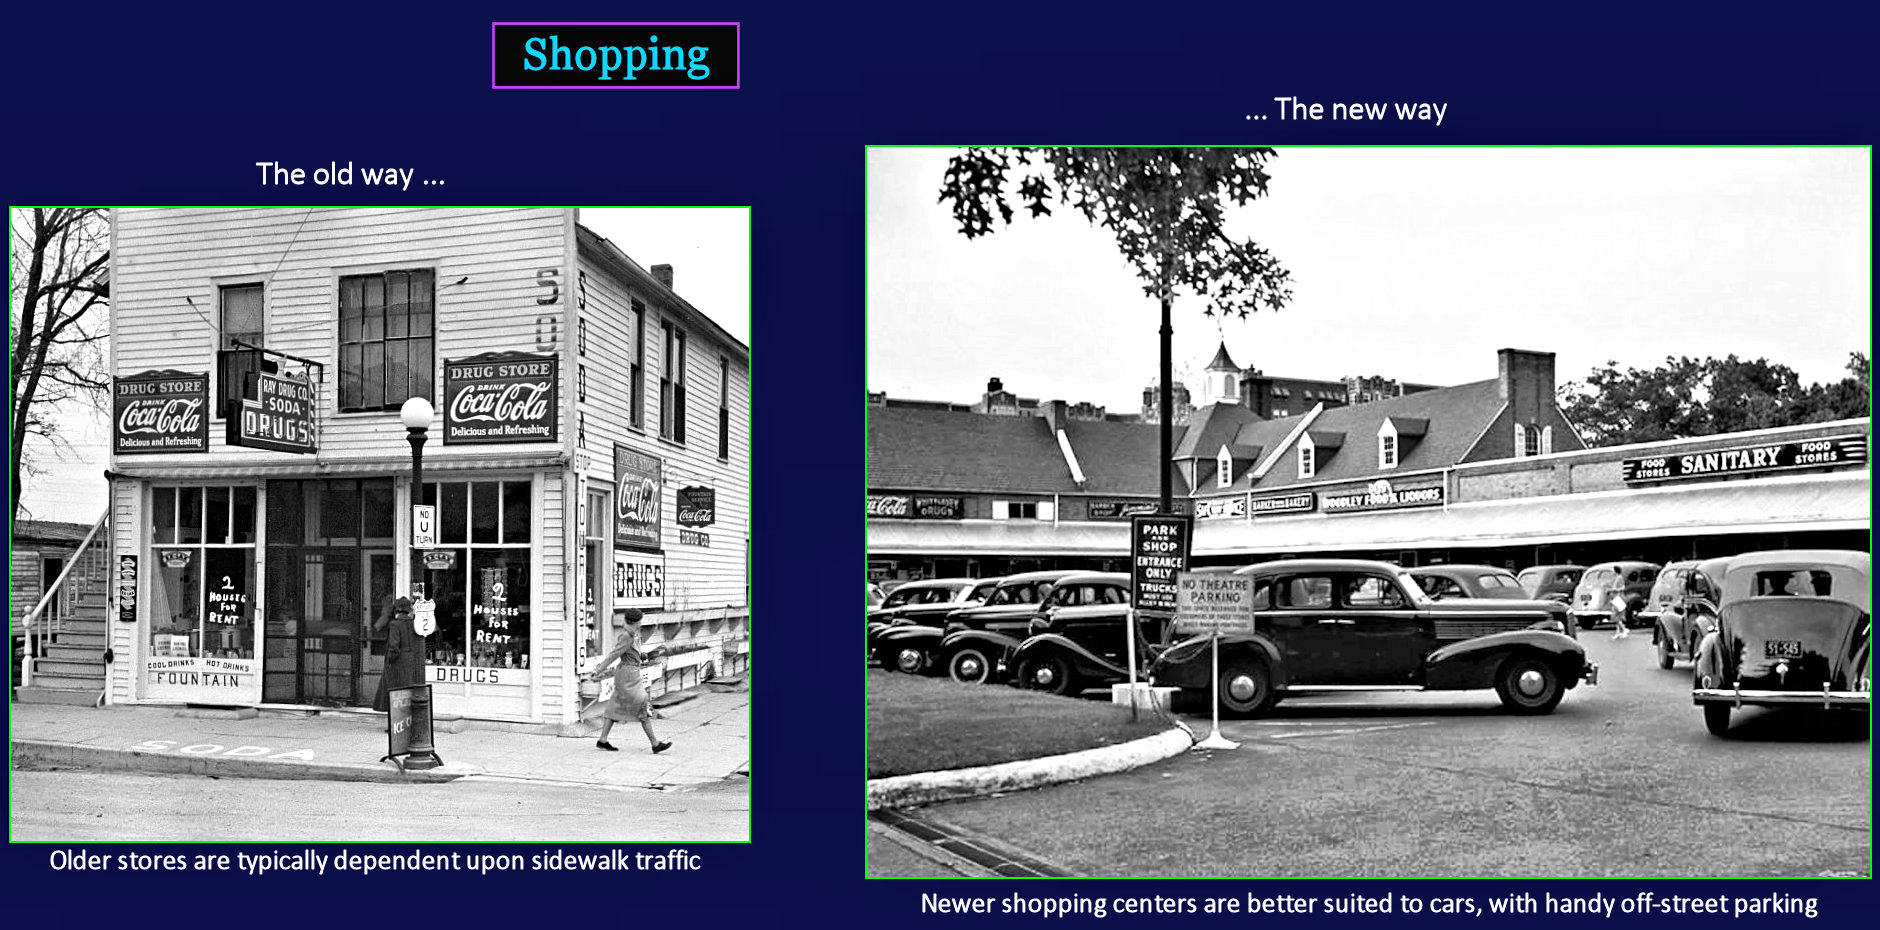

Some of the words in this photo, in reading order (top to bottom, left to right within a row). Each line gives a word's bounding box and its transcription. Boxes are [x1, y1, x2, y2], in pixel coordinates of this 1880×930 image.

[578, 270, 587, 449] SODA
[451, 366, 494, 379] DRUG
[499, 363, 551, 376] STORE
[119, 382, 156, 395] DRUG
[159, 380, 202, 393] STORE
[263, 379, 277, 395] RAY
[278, 382, 296, 399] DRUG
[269, 397, 301, 415] SODA
[450, 381, 551, 423] Coca-Cola
[119, 398, 203, 435] Coca-Cola
[245, 410, 308, 443] DRUGS
[451, 426, 486, 436] Delicious
[488, 425, 503, 435] and
[505, 424, 549, 436] Refreshing
[120, 437, 150, 447] Delicious
[152, 437, 164, 446] and
[165, 436, 202, 448] Refreshing
[1801, 441, 1832, 452] FOOD
[1641, 459, 1666, 468] FOOD
[1681, 447, 1781, 474] SANITARY
[1795, 451, 1838, 464] STORES
[1636, 468, 1670, 478] STORES
[419, 511, 430, 519] NO
[420, 521, 429, 532] U
[1143, 525, 1178, 535] PARK
[415, 535, 433, 544] TURN
[1142, 541, 1178, 552] SHOP
[1137, 556, 1182, 568] ENTRANCE
[578, 479, 586, 667] TOURISTS
[616, 561, 662, 598] DRUGS
[1145, 567, 1172, 579] ONLY
[221, 576, 235, 590] 2
[1140, 583, 1178, 594] TRUCKS
[1182, 580, 1196, 591] NO
[1200, 580, 1249, 592] THEATRE
[209, 591, 247, 603] HOUSES
[492, 583, 507, 601] 2
[1190, 591, 1241, 603] PARKING
[473, 604, 519, 616] HOUSES
[209, 612, 239, 625] RENT
[476, 629, 511, 644] RENT
[147, 660, 167, 669] COOL
[168, 659, 195, 668] DRINKS
[206, 660, 220, 668] HOT
[223, 662, 250, 672] DRINKS
[157, 672, 239, 687] FOUNTAIN
[436, 667, 499, 683] DRUGS
[130, 740, 314, 761] SODA
